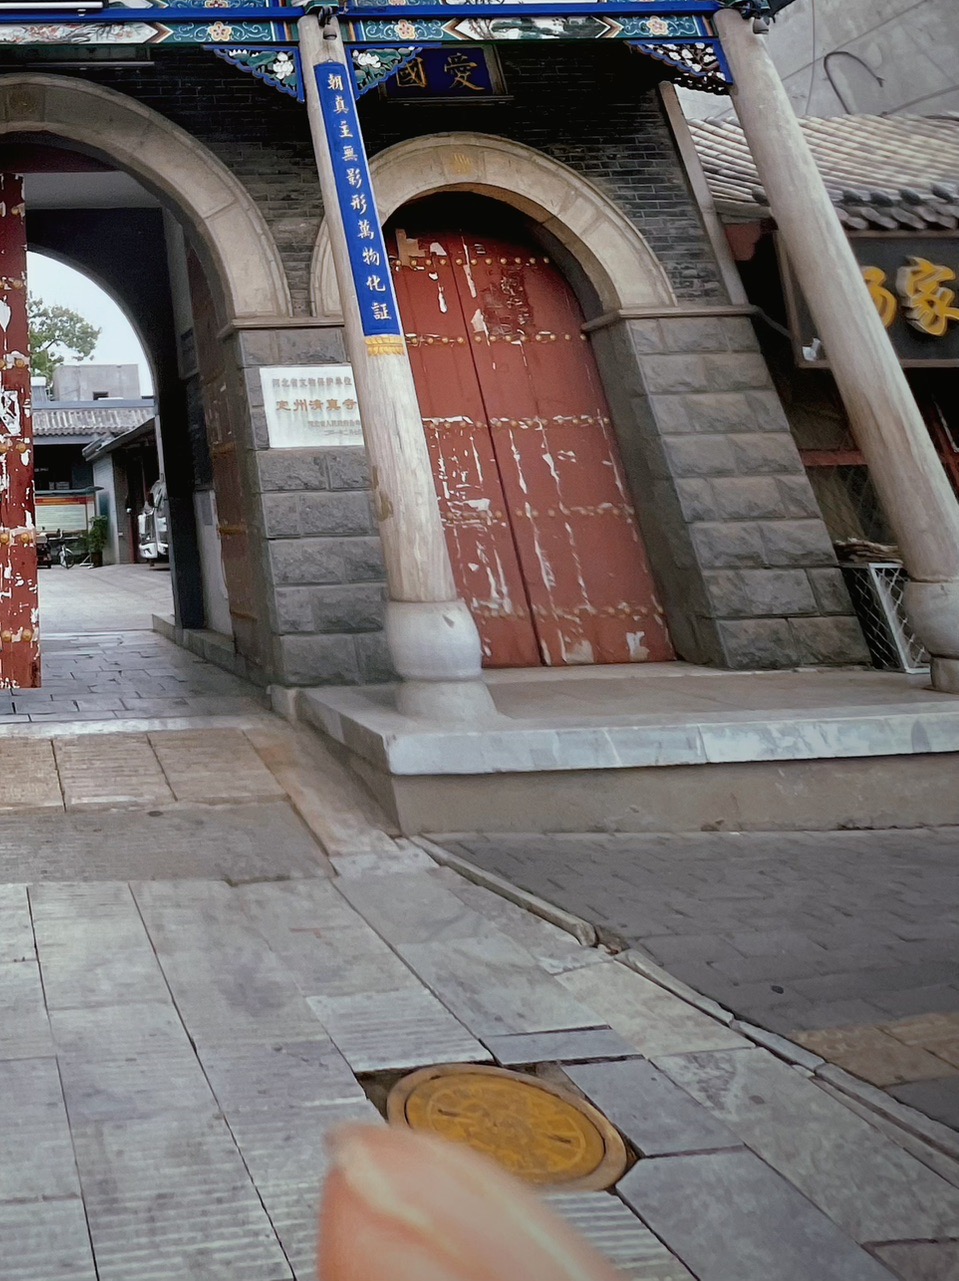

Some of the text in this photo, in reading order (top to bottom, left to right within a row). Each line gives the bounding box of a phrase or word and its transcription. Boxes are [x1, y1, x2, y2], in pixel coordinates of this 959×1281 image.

[276, 398, 357, 411] 定州清真寺
